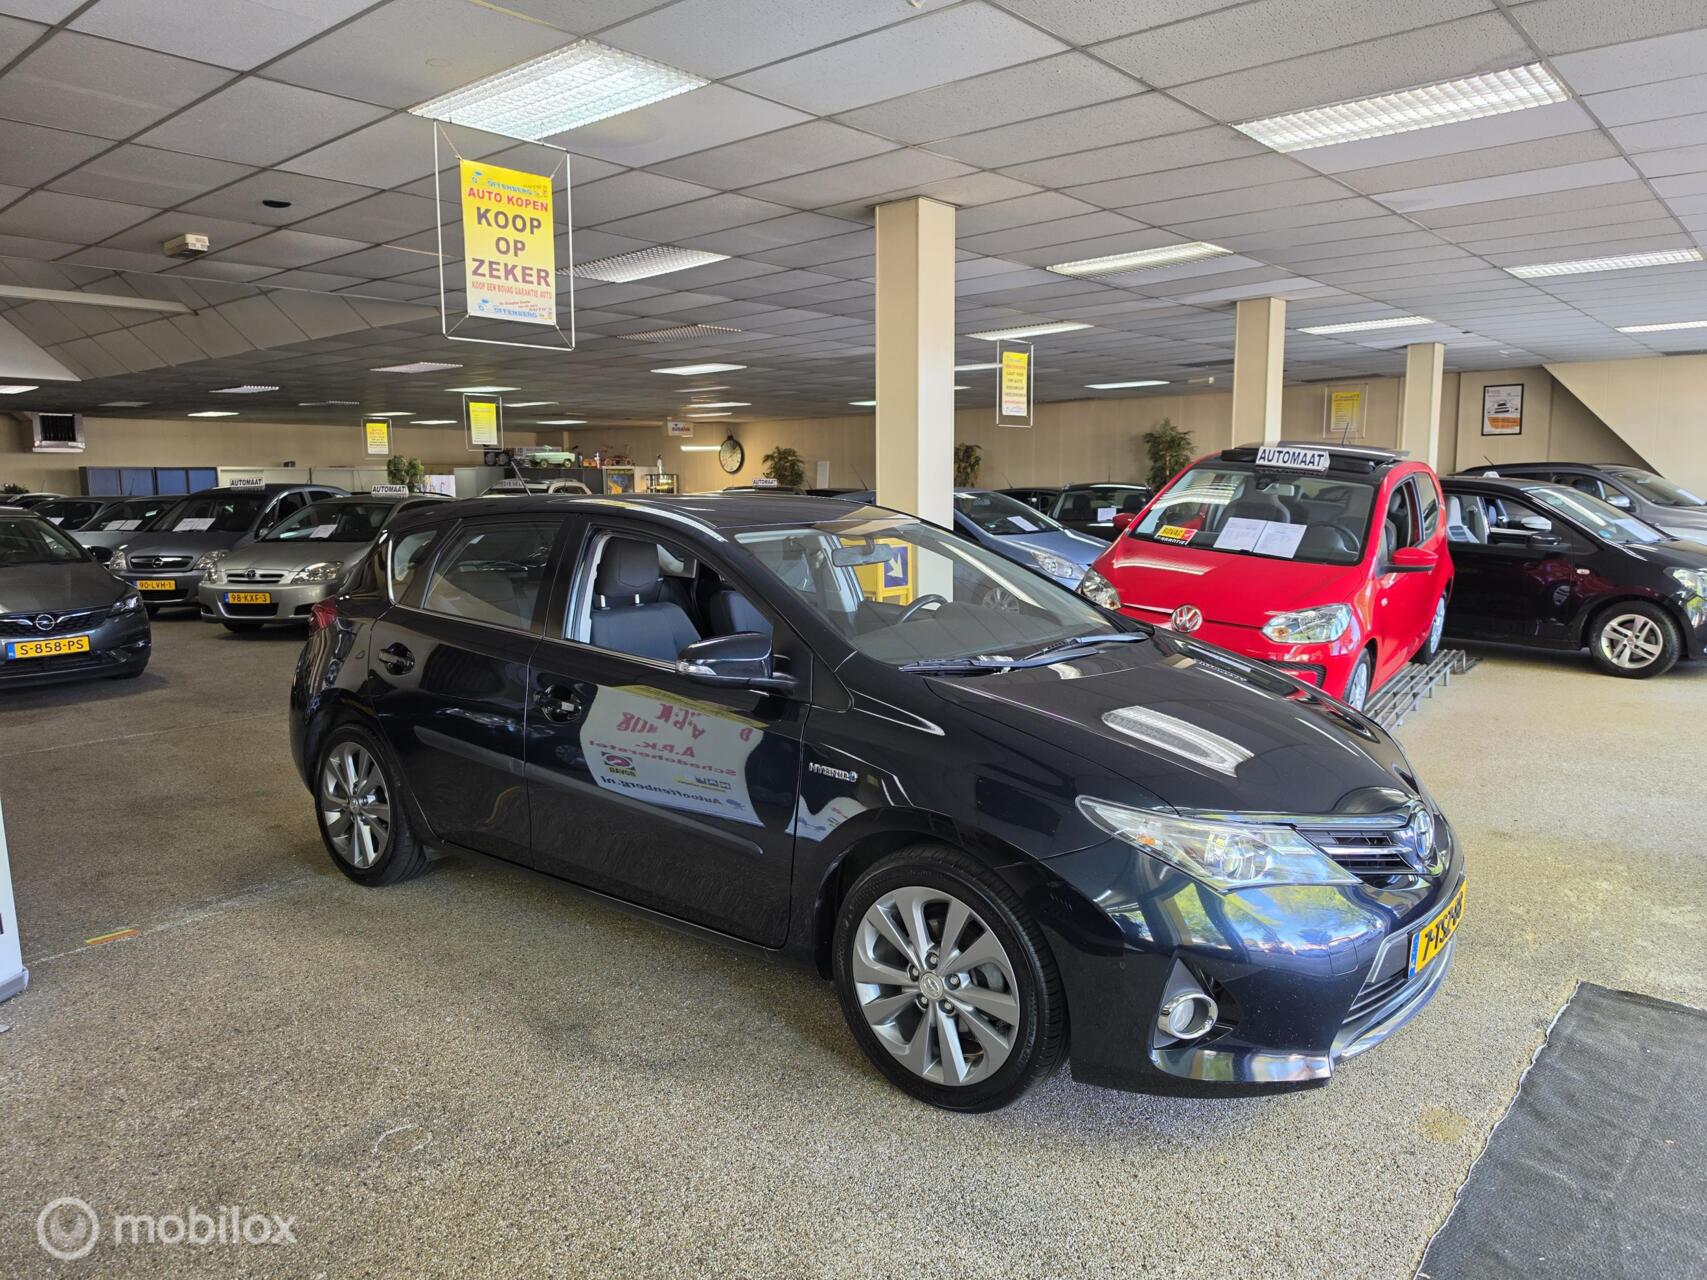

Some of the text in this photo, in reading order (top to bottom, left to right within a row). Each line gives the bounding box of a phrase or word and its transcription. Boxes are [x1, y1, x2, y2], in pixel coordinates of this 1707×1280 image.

[467, 187, 503, 203] AUTO
[506, 195, 549, 213] KOPEN
[476, 206, 542, 235] KOOP
[494, 236, 527, 258] OP
[471, 257, 551, 287] ZEKER
[1257, 448, 1325, 467] AUTOMAAT
[230, 479, 263, 487] AUTOMAAT
[372, 485, 407, 494] AUTOMAAT
[752, 479, 776, 487] AUTOMAAT
[139, 581, 173, 589] 90-LVH-1
[230, 593, 268, 603] 98-KXF-3
[20, 639, 84, 656] S-858-PS
